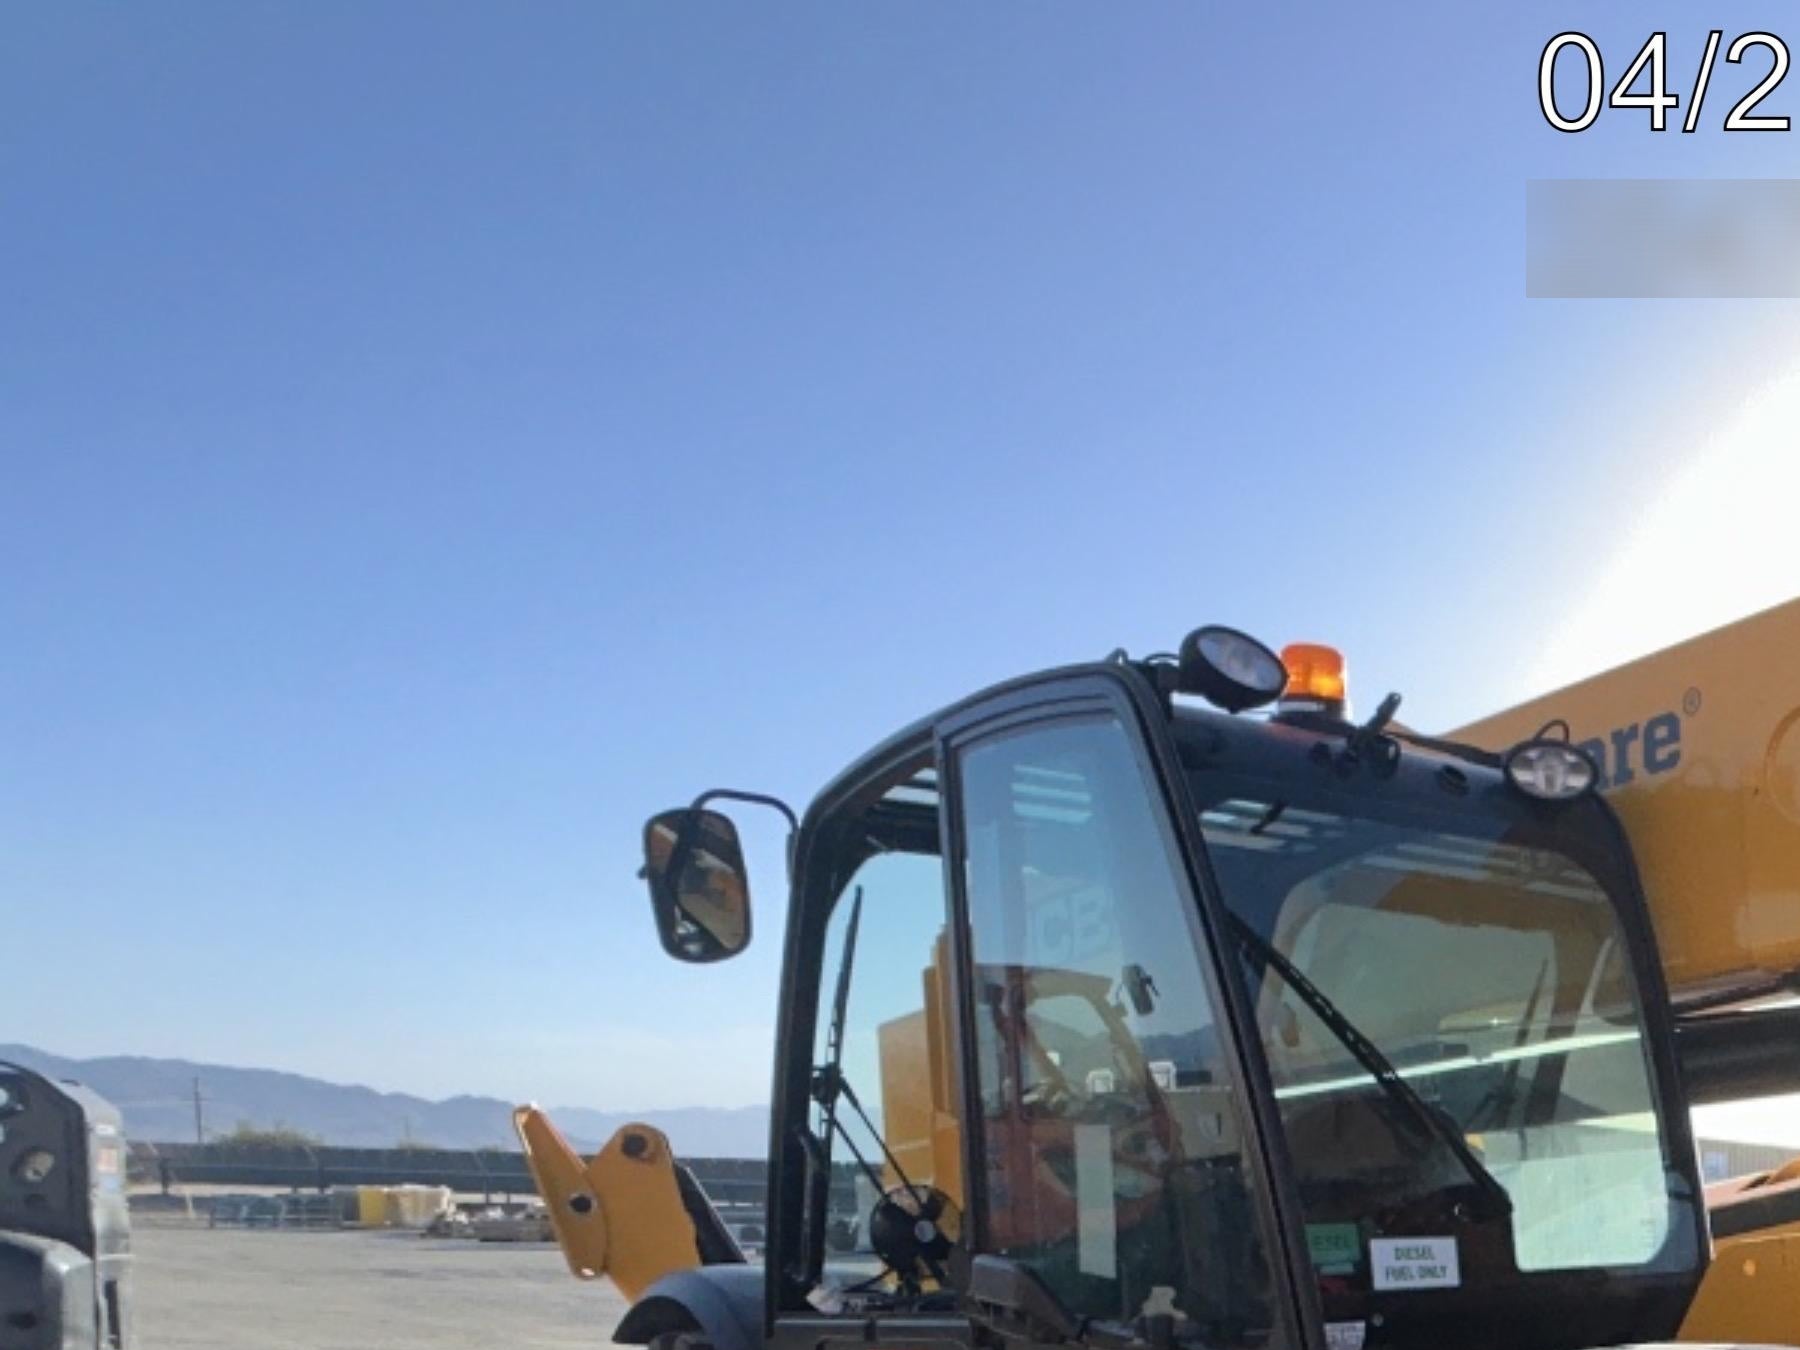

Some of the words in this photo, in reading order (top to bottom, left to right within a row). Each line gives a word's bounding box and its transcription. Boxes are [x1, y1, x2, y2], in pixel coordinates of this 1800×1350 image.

[1393, 1245, 1437, 1261] DIESEL
[1385, 1267, 1414, 1281] FUEL
[1417, 1265, 1449, 1280] ONLY
